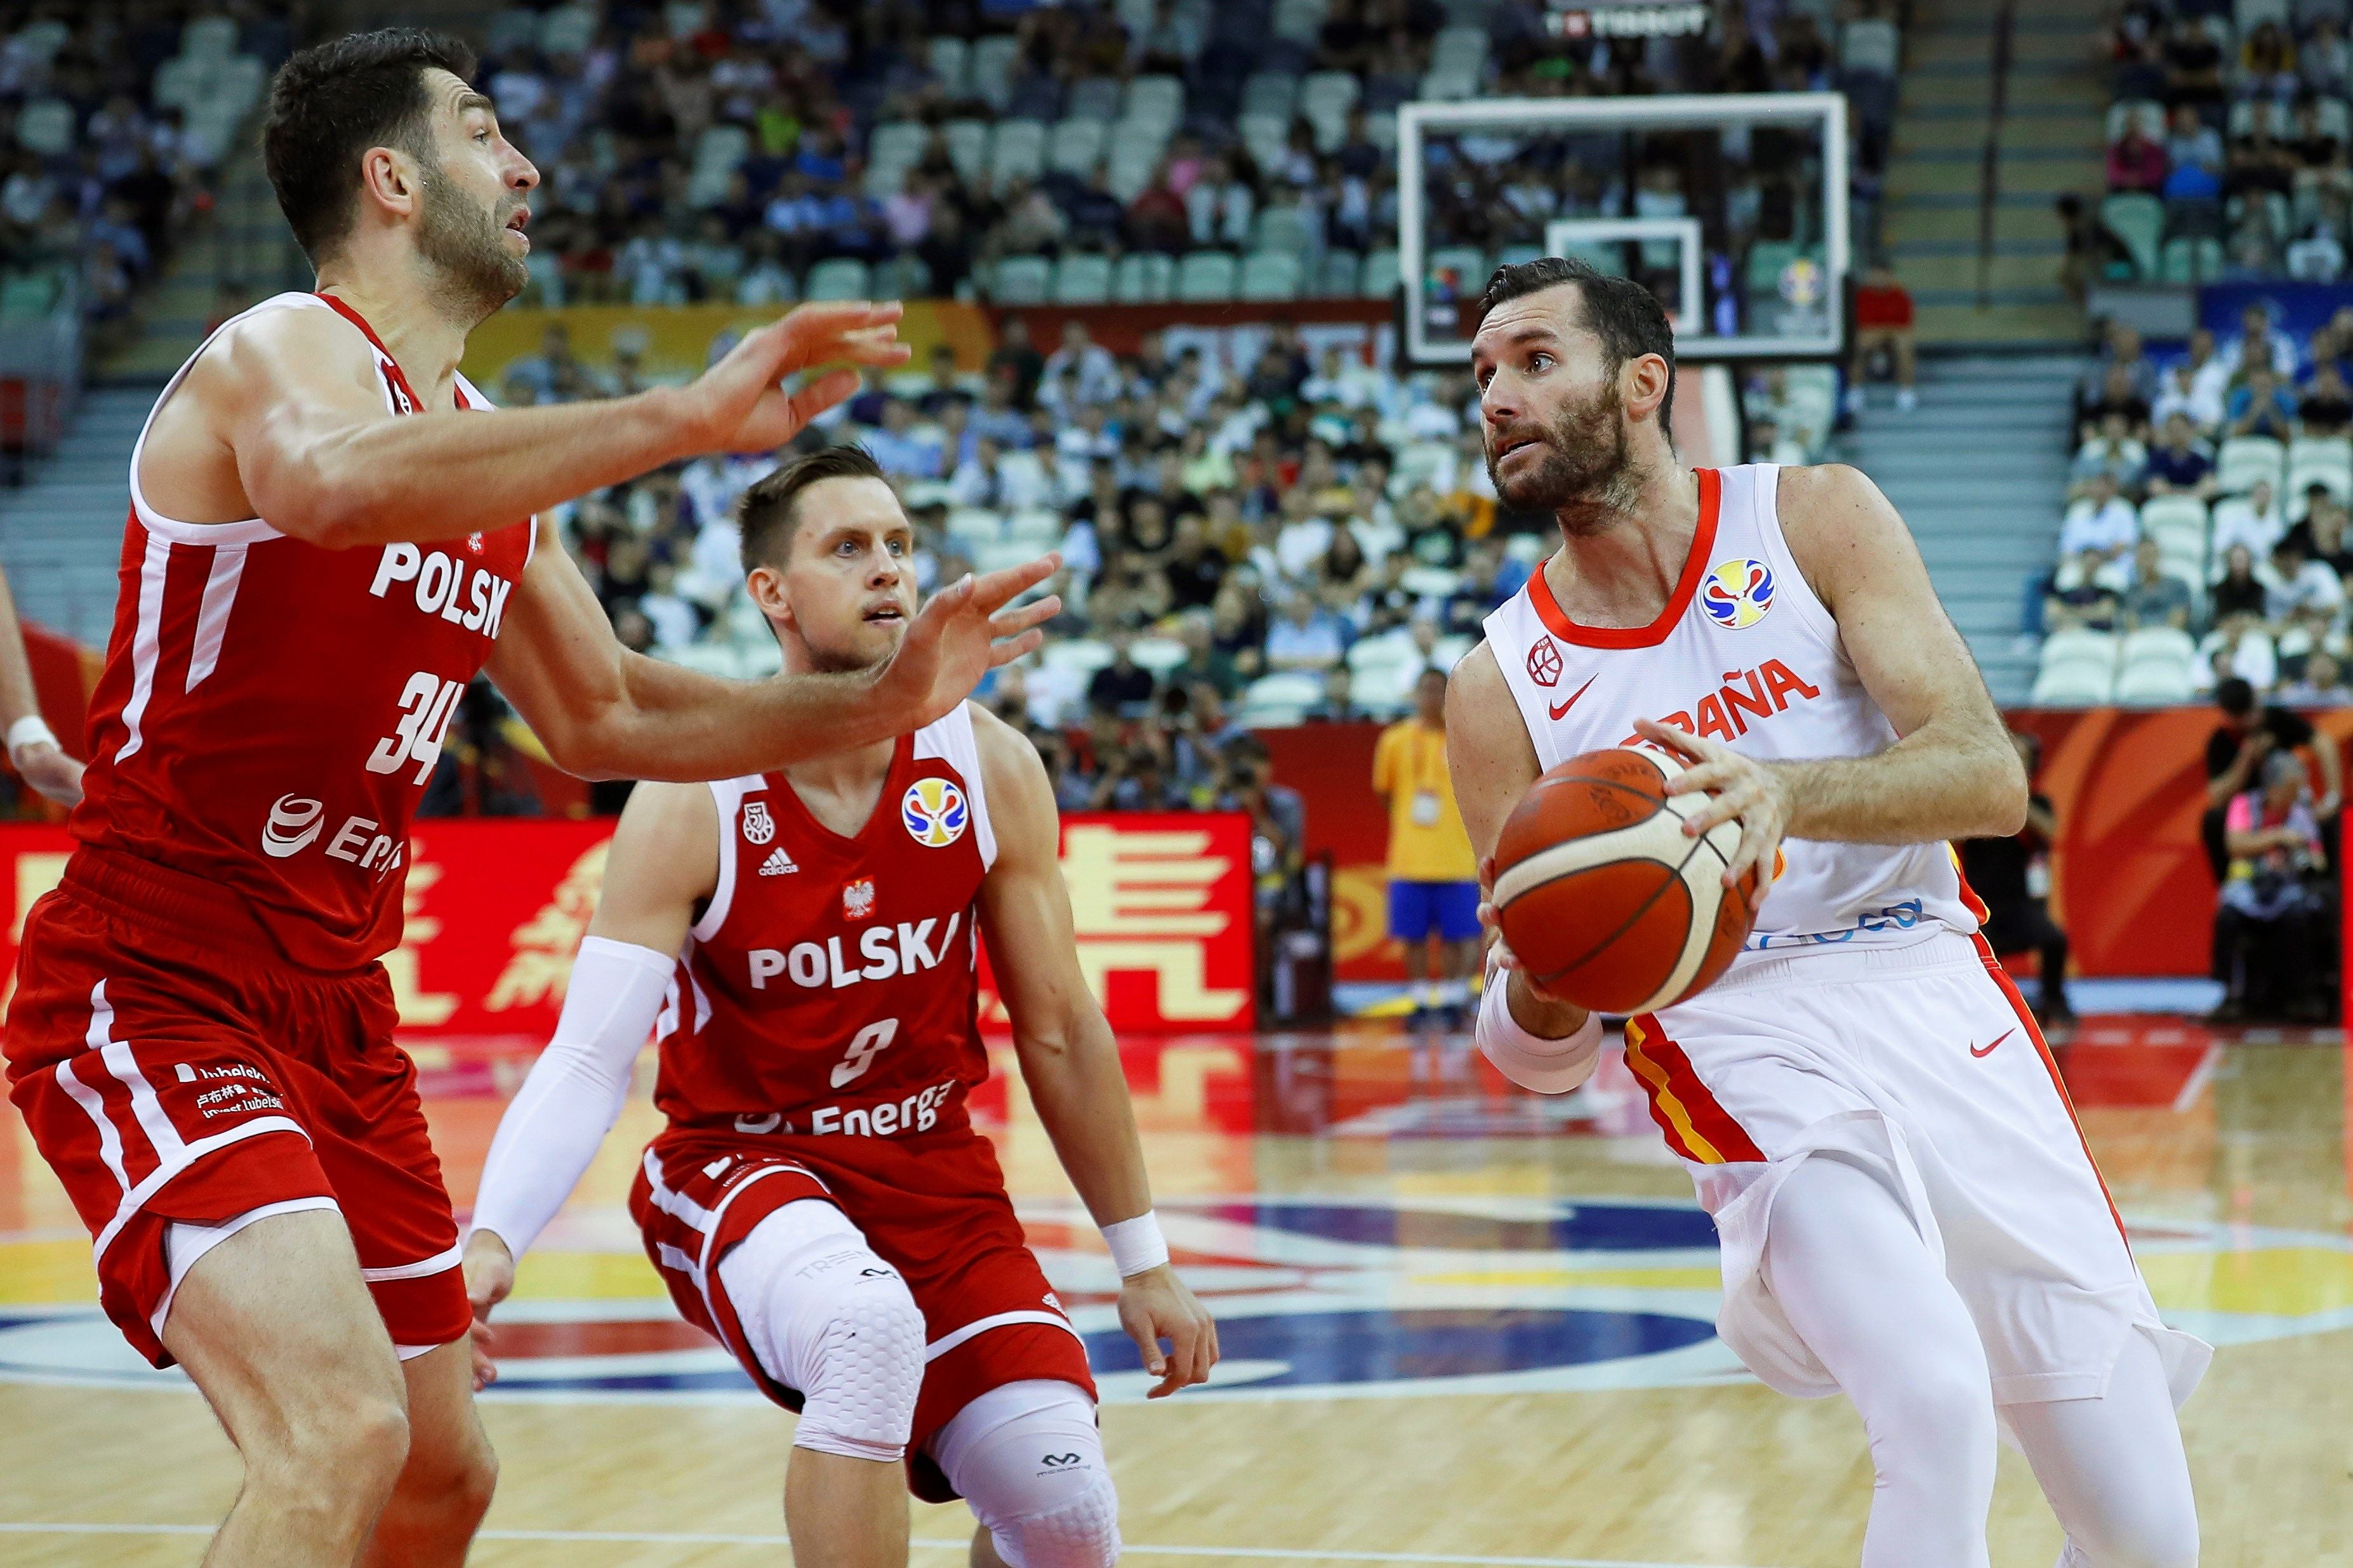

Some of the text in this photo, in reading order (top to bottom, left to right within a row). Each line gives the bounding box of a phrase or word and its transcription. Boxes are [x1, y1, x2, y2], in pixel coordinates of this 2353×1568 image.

[369, 541, 512, 640] POLSK
[366, 671, 465, 786] 34
[1619, 659, 1820, 772] PAÑA
[759, 864, 799, 876] adidas
[830, 1018, 899, 1089] 9
